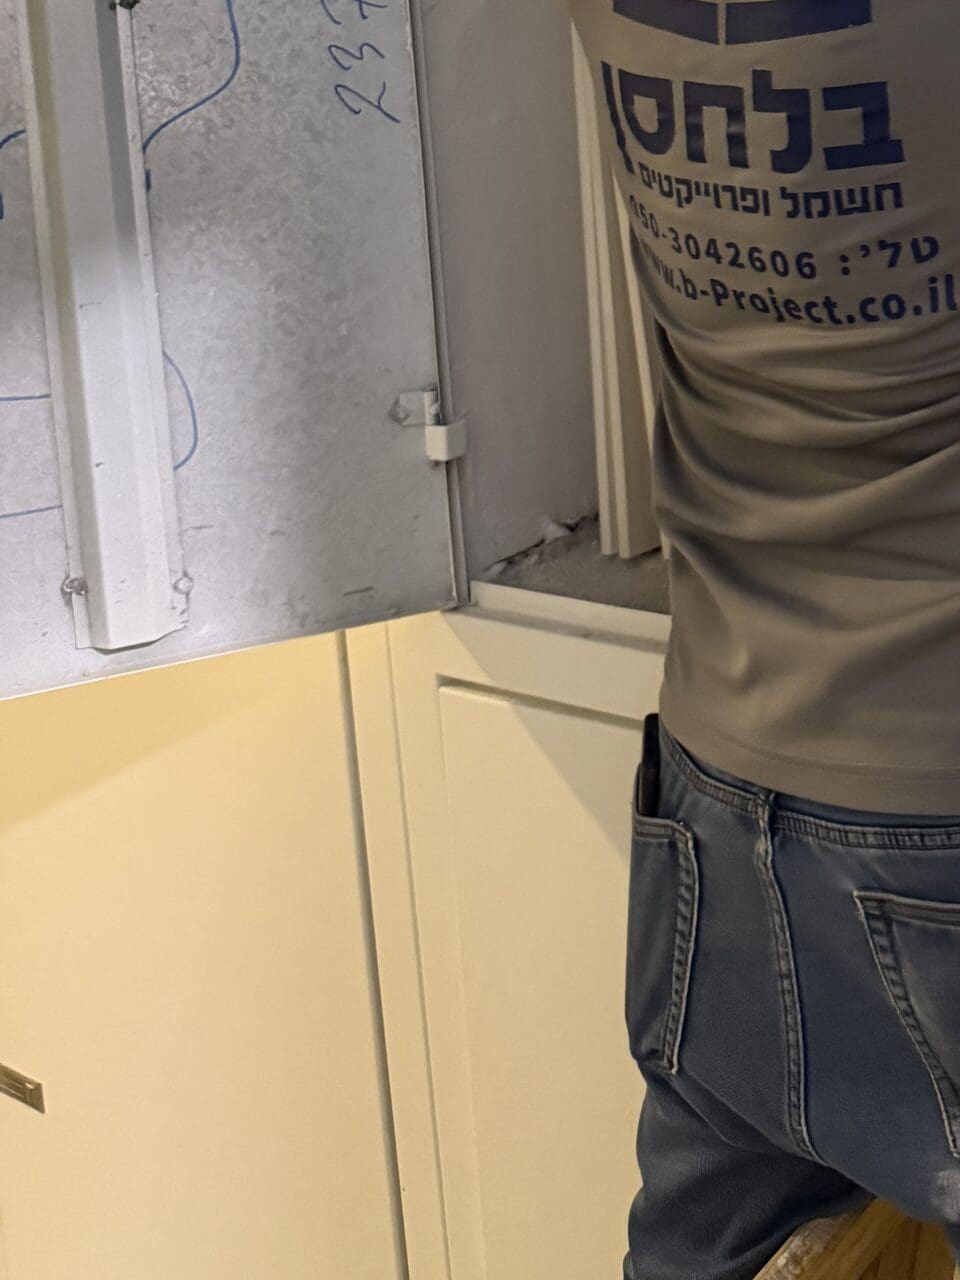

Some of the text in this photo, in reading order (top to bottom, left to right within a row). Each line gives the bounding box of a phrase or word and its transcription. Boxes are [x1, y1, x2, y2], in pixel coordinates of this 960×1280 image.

[600, 60, 906, 174] בלחסן
[638, 161, 904, 219] חשמל ופרוייקטים
